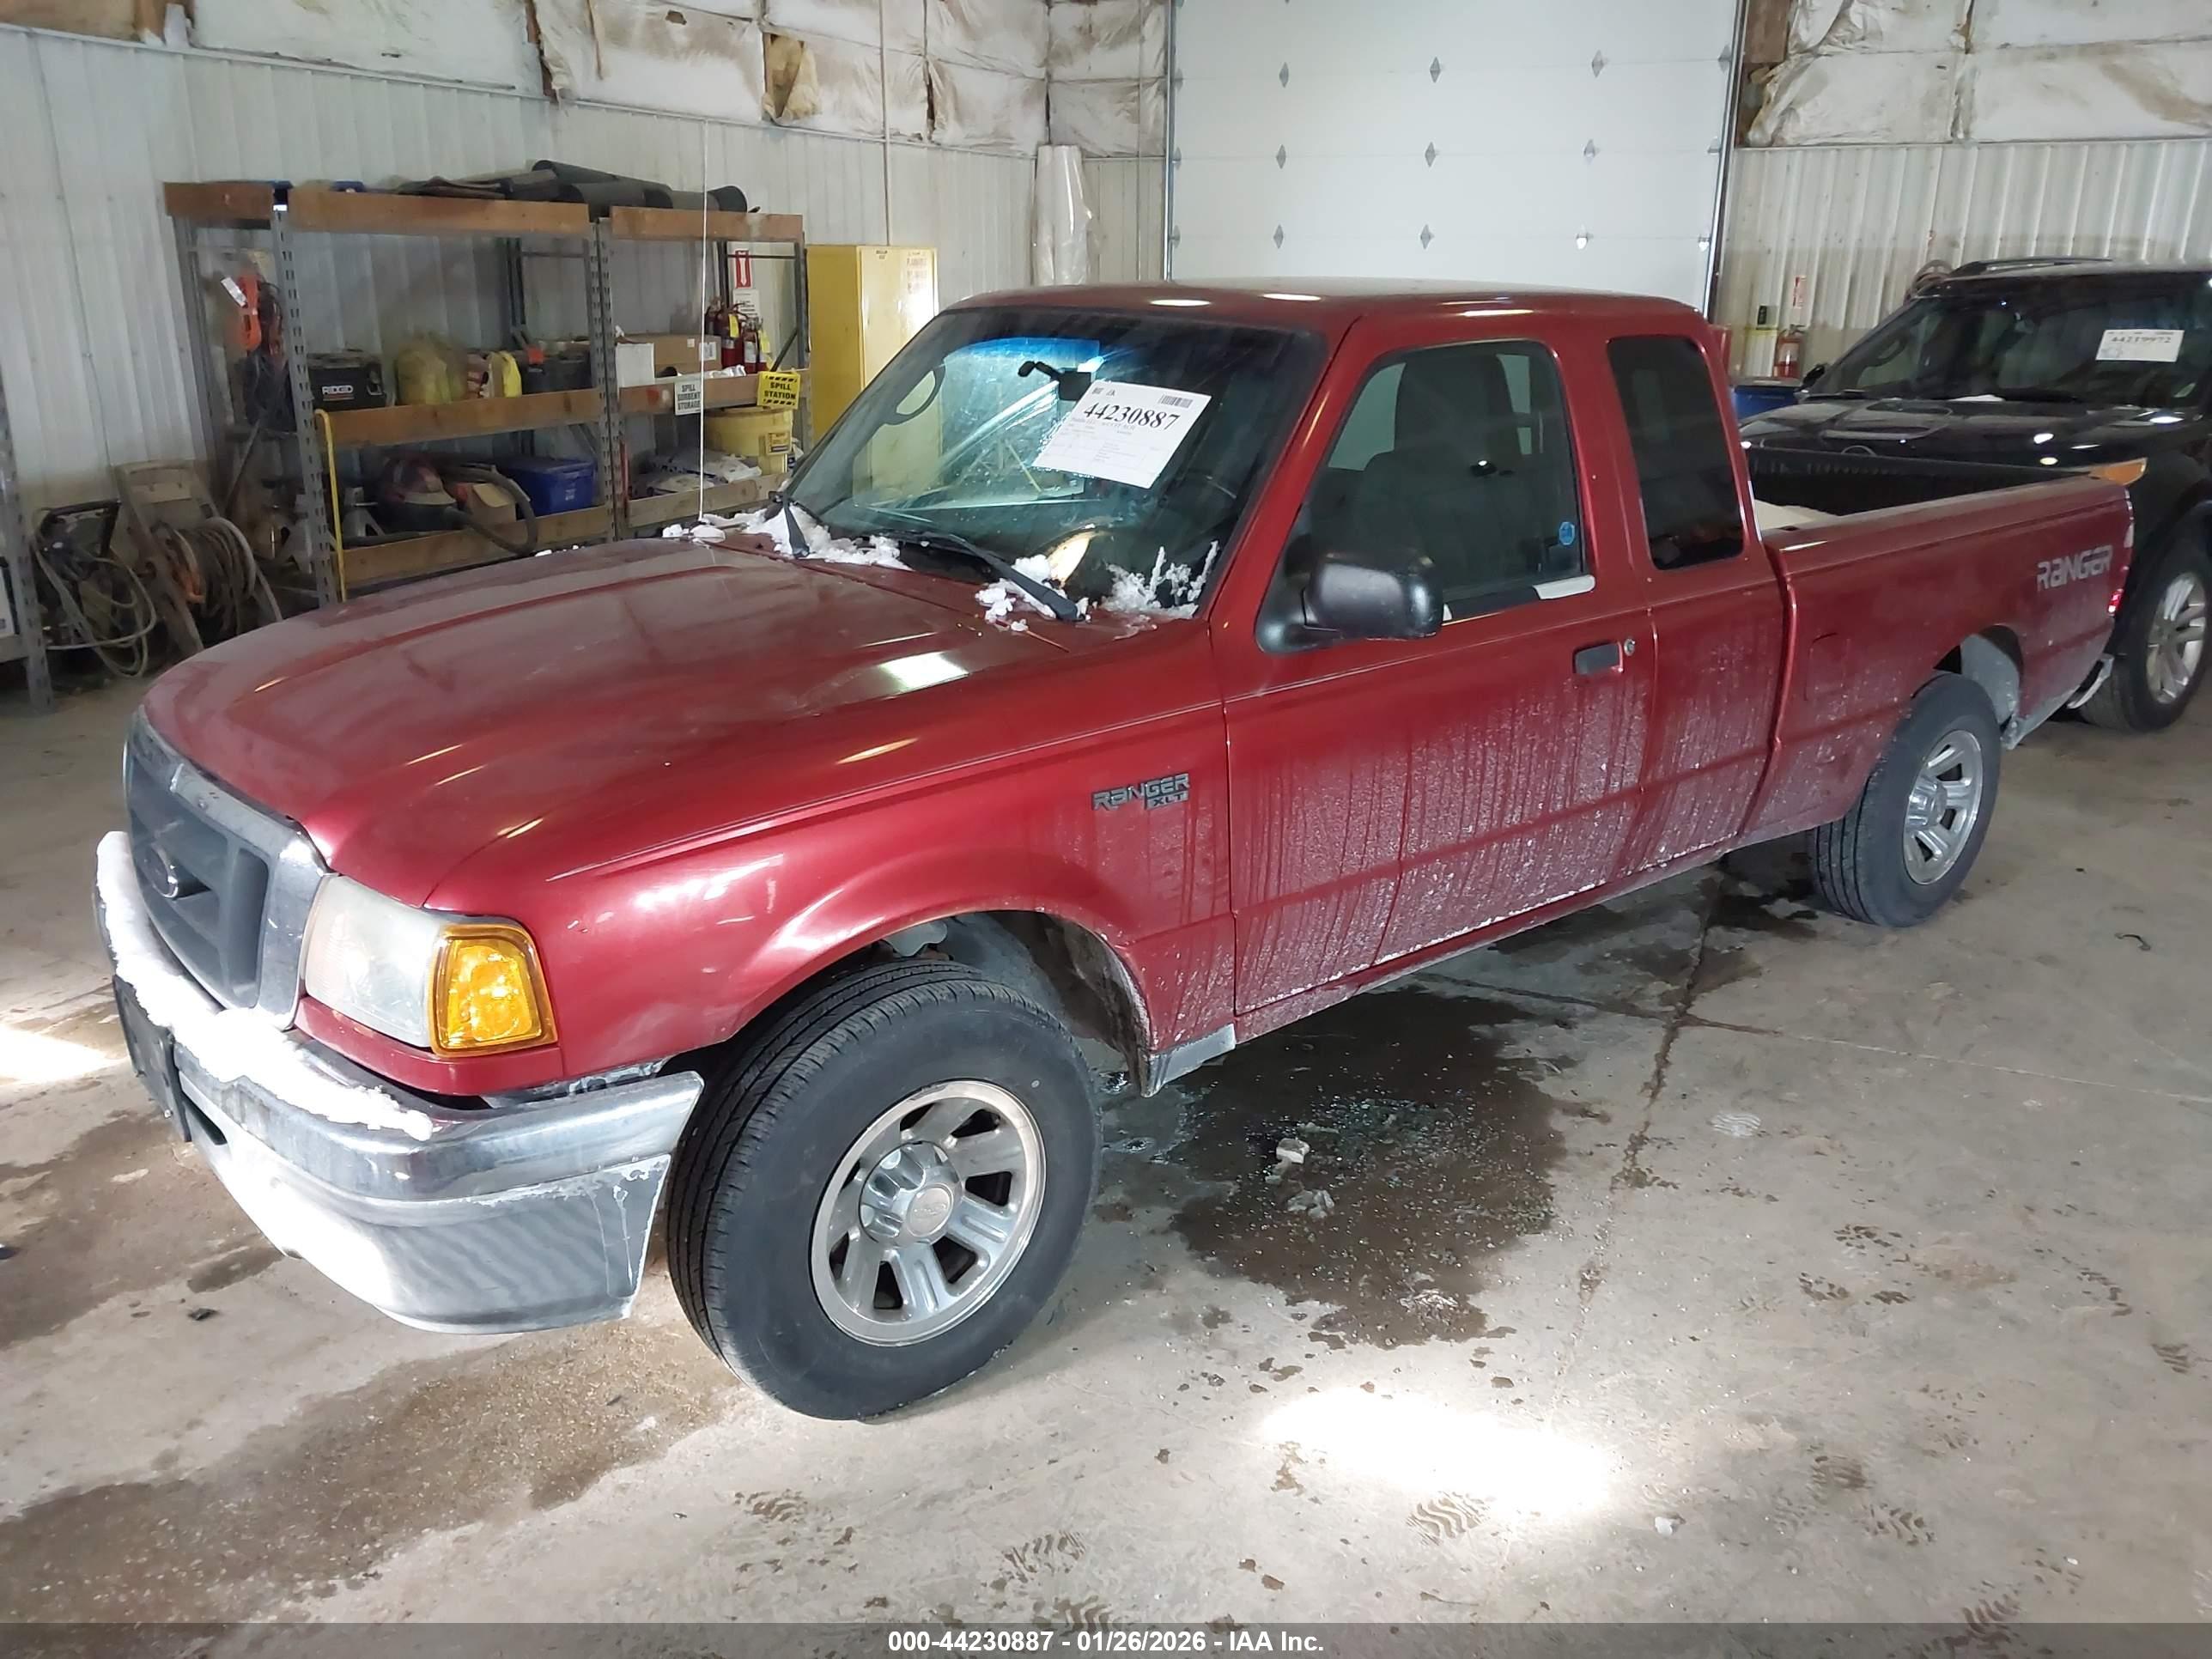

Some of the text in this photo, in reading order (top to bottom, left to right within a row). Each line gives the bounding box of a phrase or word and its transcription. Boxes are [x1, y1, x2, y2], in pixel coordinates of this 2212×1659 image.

[321, 385, 354, 395] RIDGID
[681, 384, 696, 392] SPILL
[769, 381, 792, 391] SPILL
[763, 390, 797, 400] STATION
[678, 399, 702, 410] STORAGE
[1083, 401, 1182, 430] 44230887
[2036, 544, 2113, 593] RANGER
[1092, 772, 1190, 811] RANGER
[1151, 792, 1186, 809] XLT
